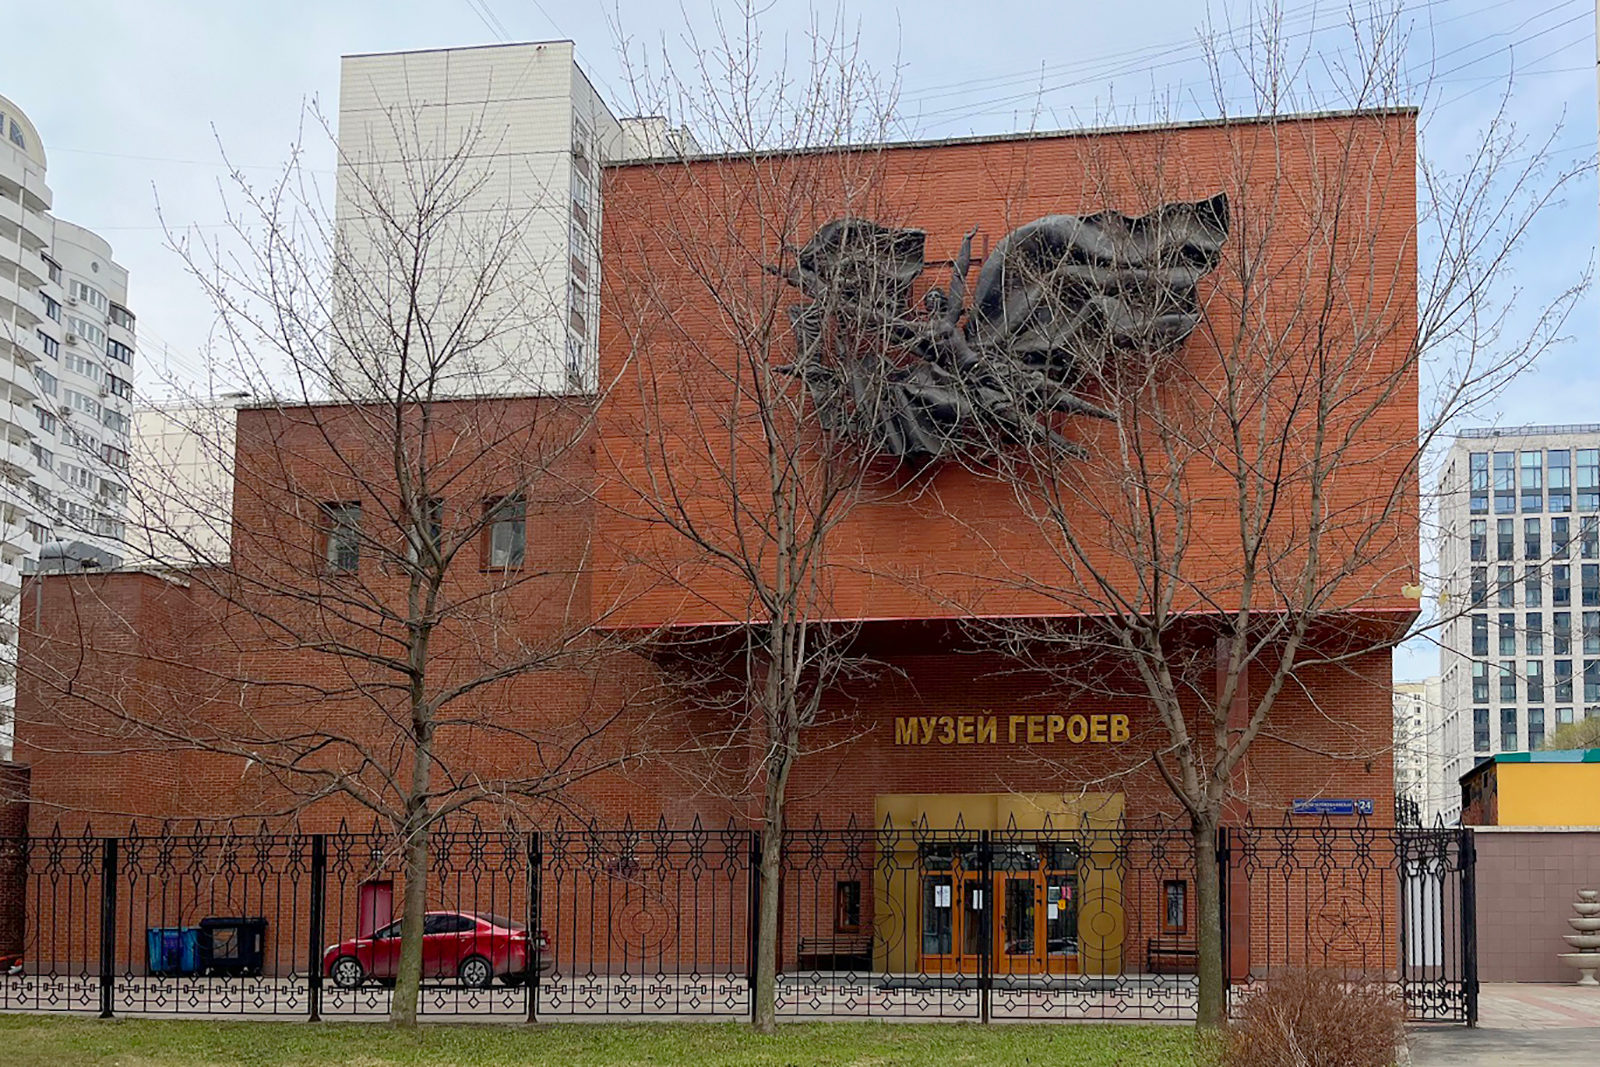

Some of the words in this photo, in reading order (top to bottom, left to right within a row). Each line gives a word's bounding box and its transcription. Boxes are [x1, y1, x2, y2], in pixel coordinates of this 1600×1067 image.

[895, 709, 998, 745] МУЗЕЙ
[1008, 713, 1131, 744] ГЕРОЕВ
[1360, 801, 1371, 810] 24
